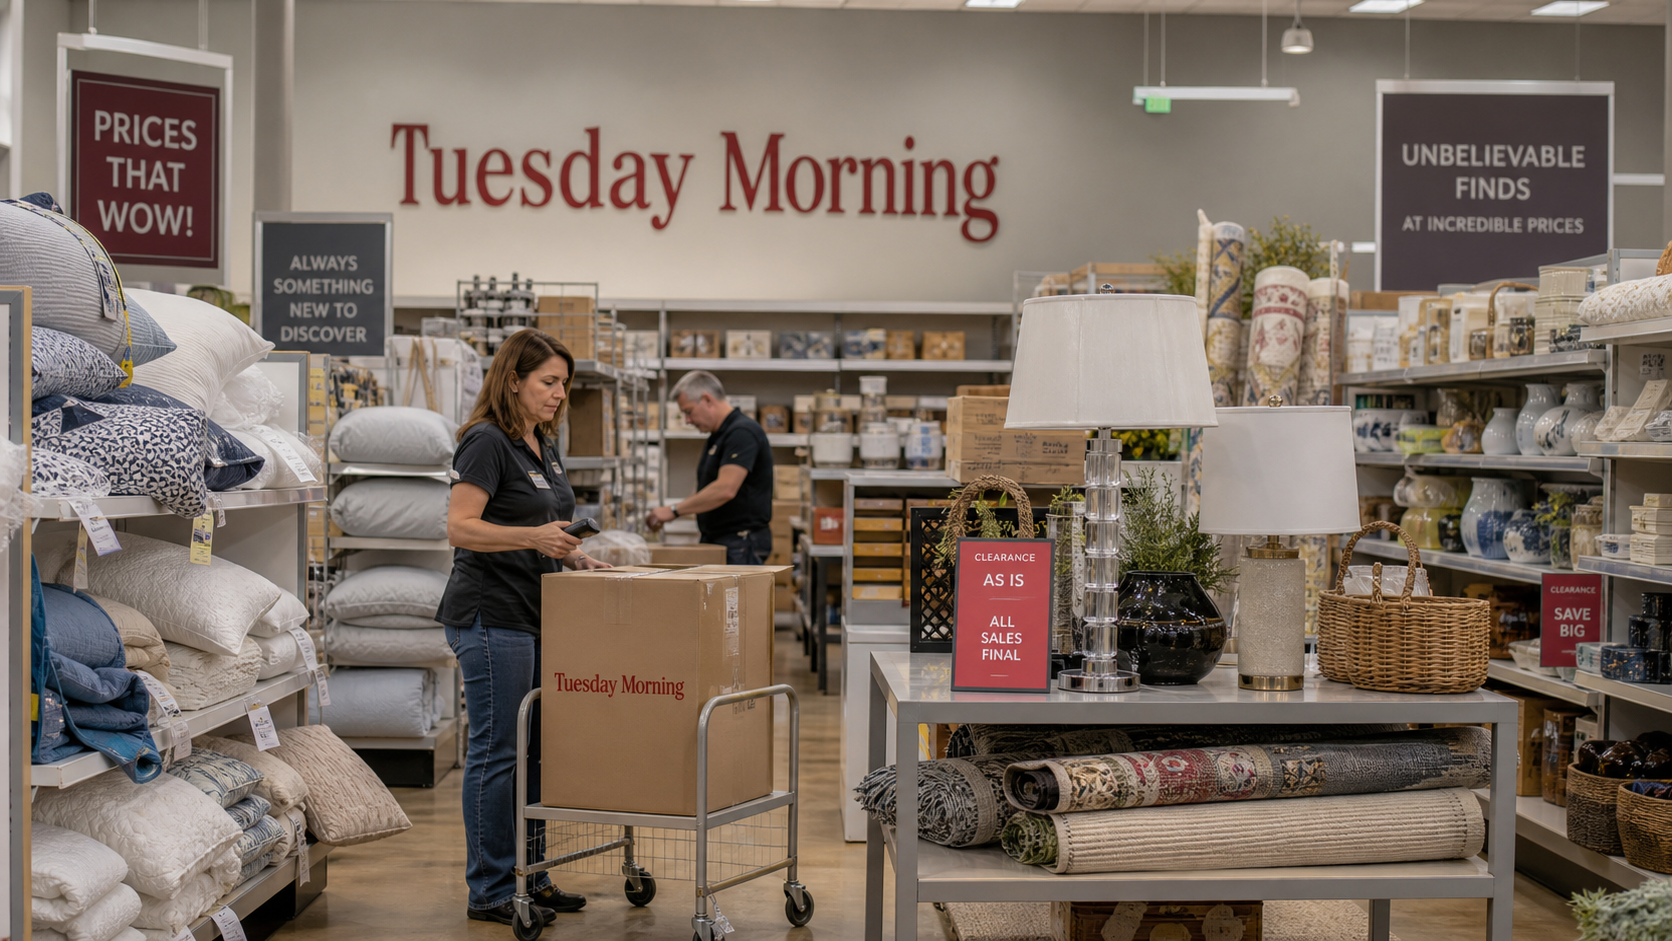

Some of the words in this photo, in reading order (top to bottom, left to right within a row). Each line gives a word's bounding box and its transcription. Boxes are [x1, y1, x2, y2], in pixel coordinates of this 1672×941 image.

[95, 110, 197, 150] PRICES
[1402, 143, 1586, 169] UNBELIEVABLE
[106, 157, 185, 192] THAT
[391, 124, 694, 231] Tuesday
[719, 131, 999, 243] Morning
[1456, 177, 1531, 200] FINDS
[98, 200, 192, 236] WOW!
[1402, 216, 1424, 232] AT
[1427, 216, 1523, 233] INCREDIBLE
[1527, 217, 1584, 234] PRICES
[290, 256, 357, 271] ALWAYS
[273, 278, 374, 295] SOMETHING
[290, 303, 329, 317] NEW
[334, 303, 357, 318] TO
[281, 326, 367, 343] DISCOVER
[974, 553, 1036, 562] CLEARANCE
[983, 573, 1005, 587] AS
[1009, 573, 1024, 587] IS
[1550, 585, 1596, 595] CLEARANCE
[989, 615, 1014, 628] ALL
[1554, 607, 1591, 621] SAVE
[981, 632, 1023, 645] SALES
[1560, 624, 1585, 637] BIG
[982, 649, 1021, 661] FINAL
[554, 673, 617, 698] Tuesday
[621, 674, 685, 701] Morning
